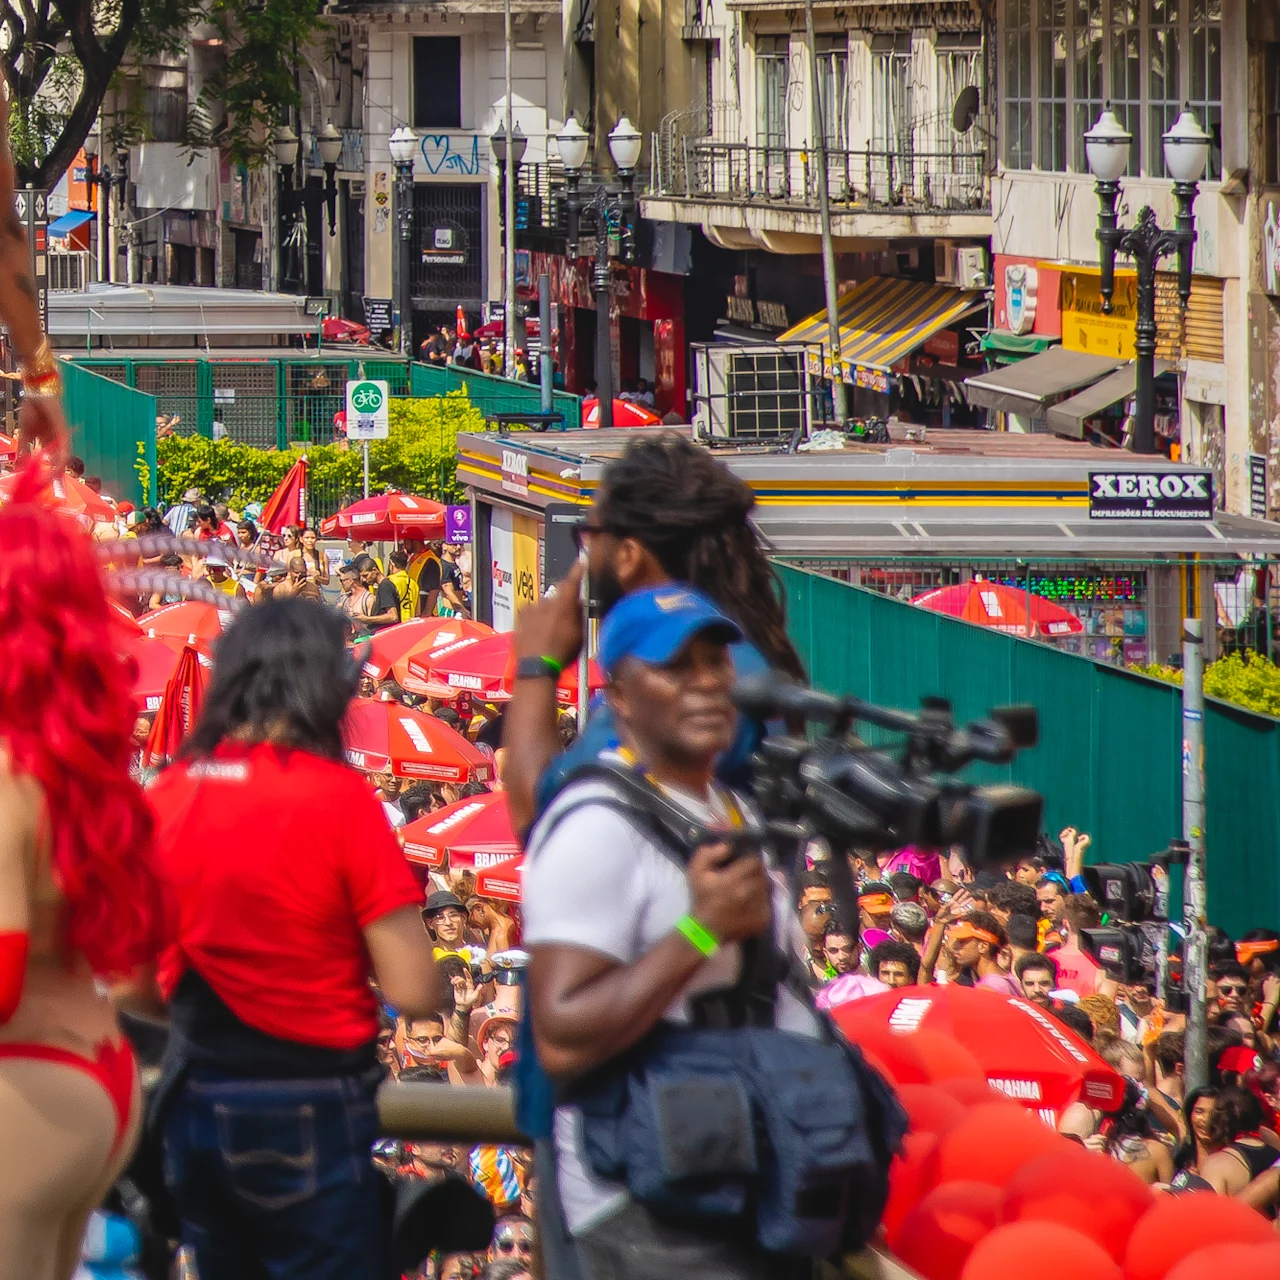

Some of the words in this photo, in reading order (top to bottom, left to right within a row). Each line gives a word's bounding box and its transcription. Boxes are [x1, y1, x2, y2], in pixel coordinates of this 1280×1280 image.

[1093, 474, 1208, 498] XEROX
[1091, 508, 1141, 517] IMPRESSÕES
[448, 673, 482, 690] BRAHMA
[474, 852, 516, 868] BRAHM
